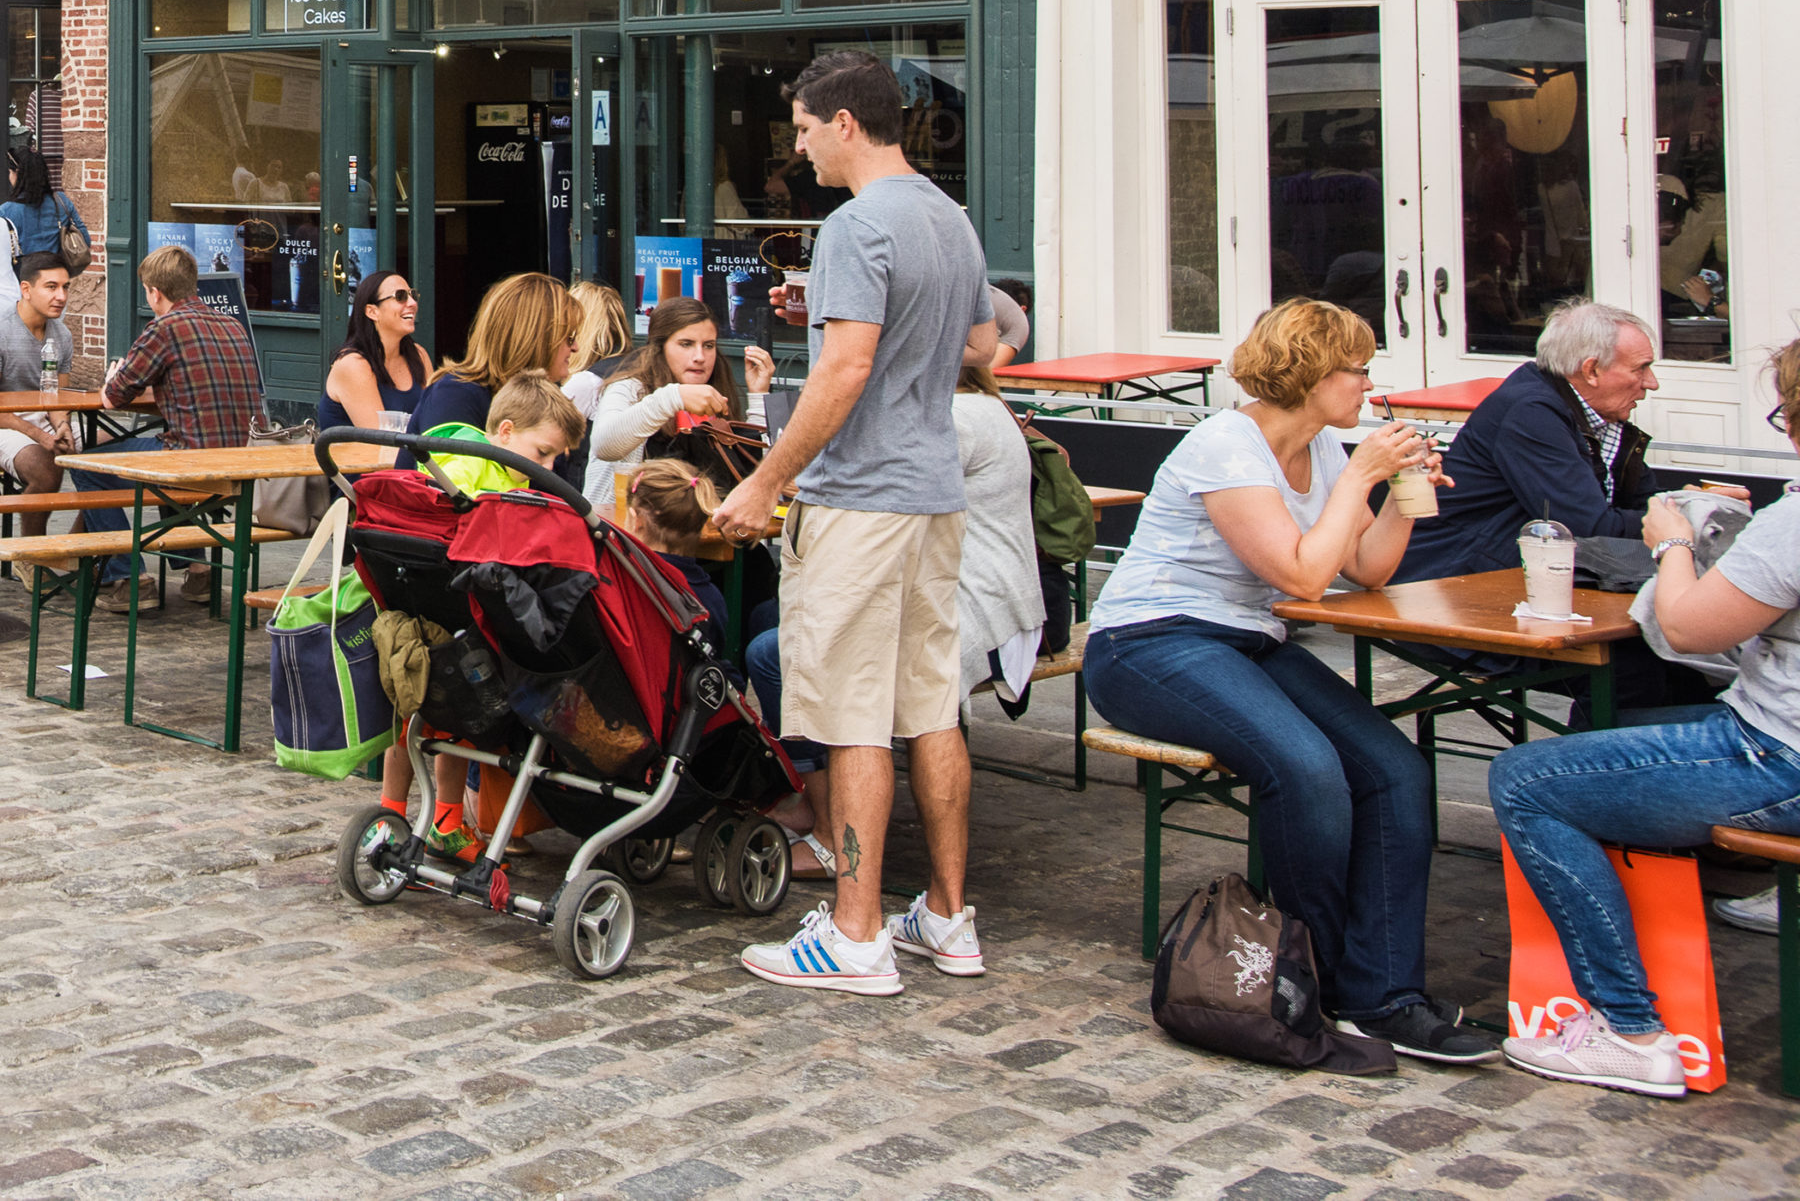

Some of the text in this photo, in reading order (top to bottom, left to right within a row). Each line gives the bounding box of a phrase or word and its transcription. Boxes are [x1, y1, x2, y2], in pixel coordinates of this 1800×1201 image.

[304, 8, 346, 24] Cakes
[594, 100, 607, 130] A
[478, 141, 527, 162] Coca-Cola
[552, 195, 568, 208] DE
[285, 239, 311, 247] DULCE
[292, 248, 318, 256] LECHE
[353, 245, 373, 253] CHIP
[640, 256, 698, 265] SMOOTHIES
[715, 256, 759, 265] BELGIAN
[707, 265, 767, 274] CHOCOLATE
[214, 305, 240, 315] ECHE
